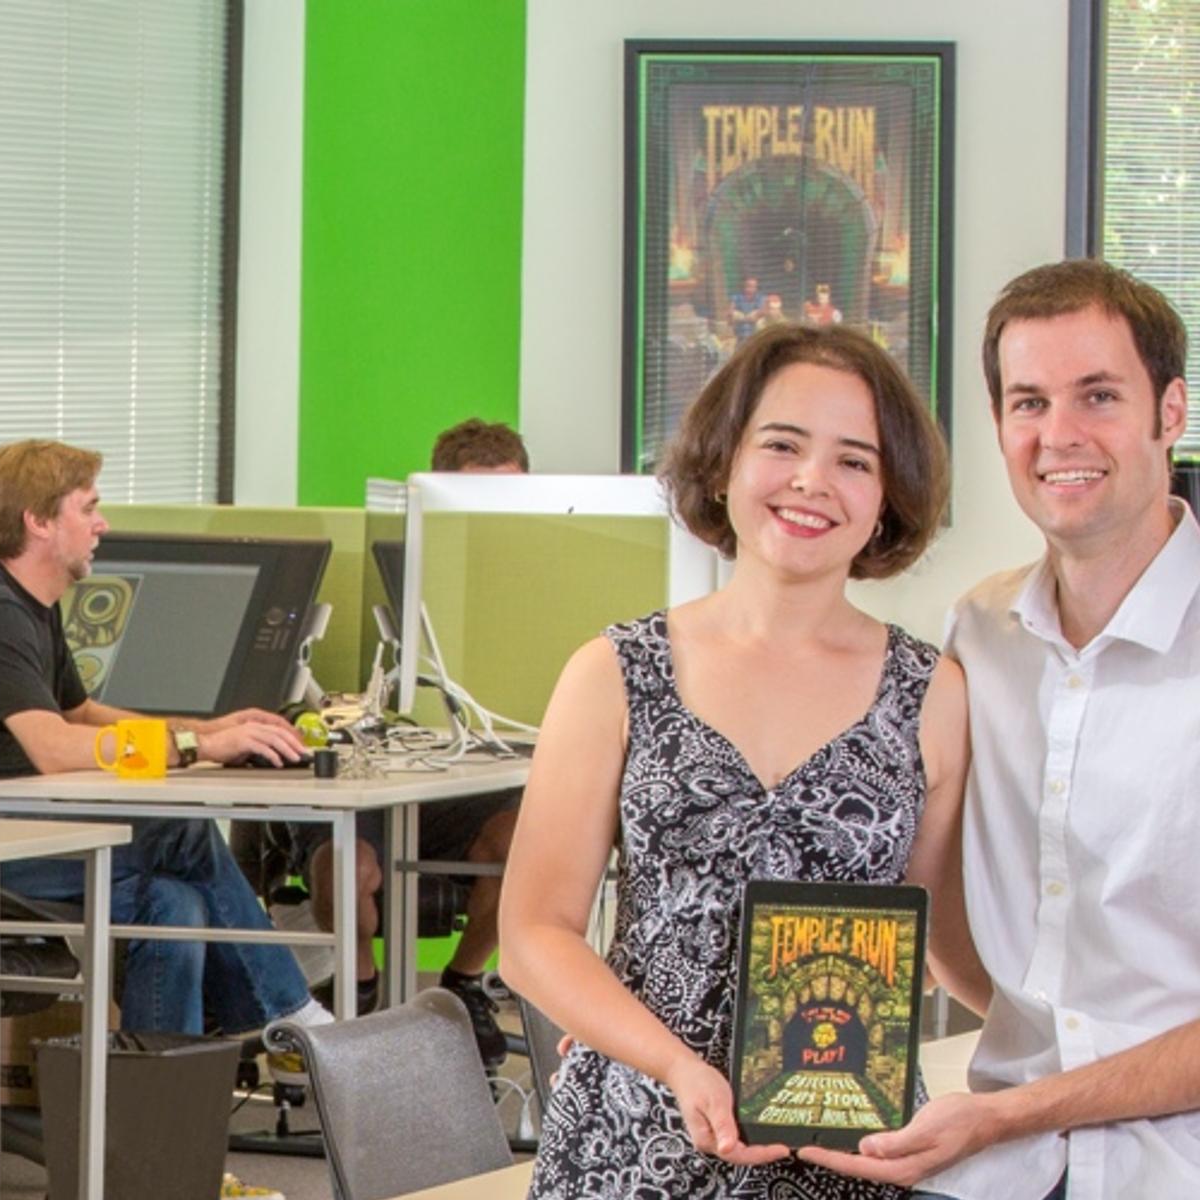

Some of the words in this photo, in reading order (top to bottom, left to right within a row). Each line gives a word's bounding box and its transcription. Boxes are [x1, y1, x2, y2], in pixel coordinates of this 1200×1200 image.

[702, 104, 804, 194] TEMPLE
[814, 105, 876, 203] RUN
[770, 915, 844, 977] TEMPLE
[851, 917, 898, 987] RUN
[823, 1091, 871, 1108] STORE
